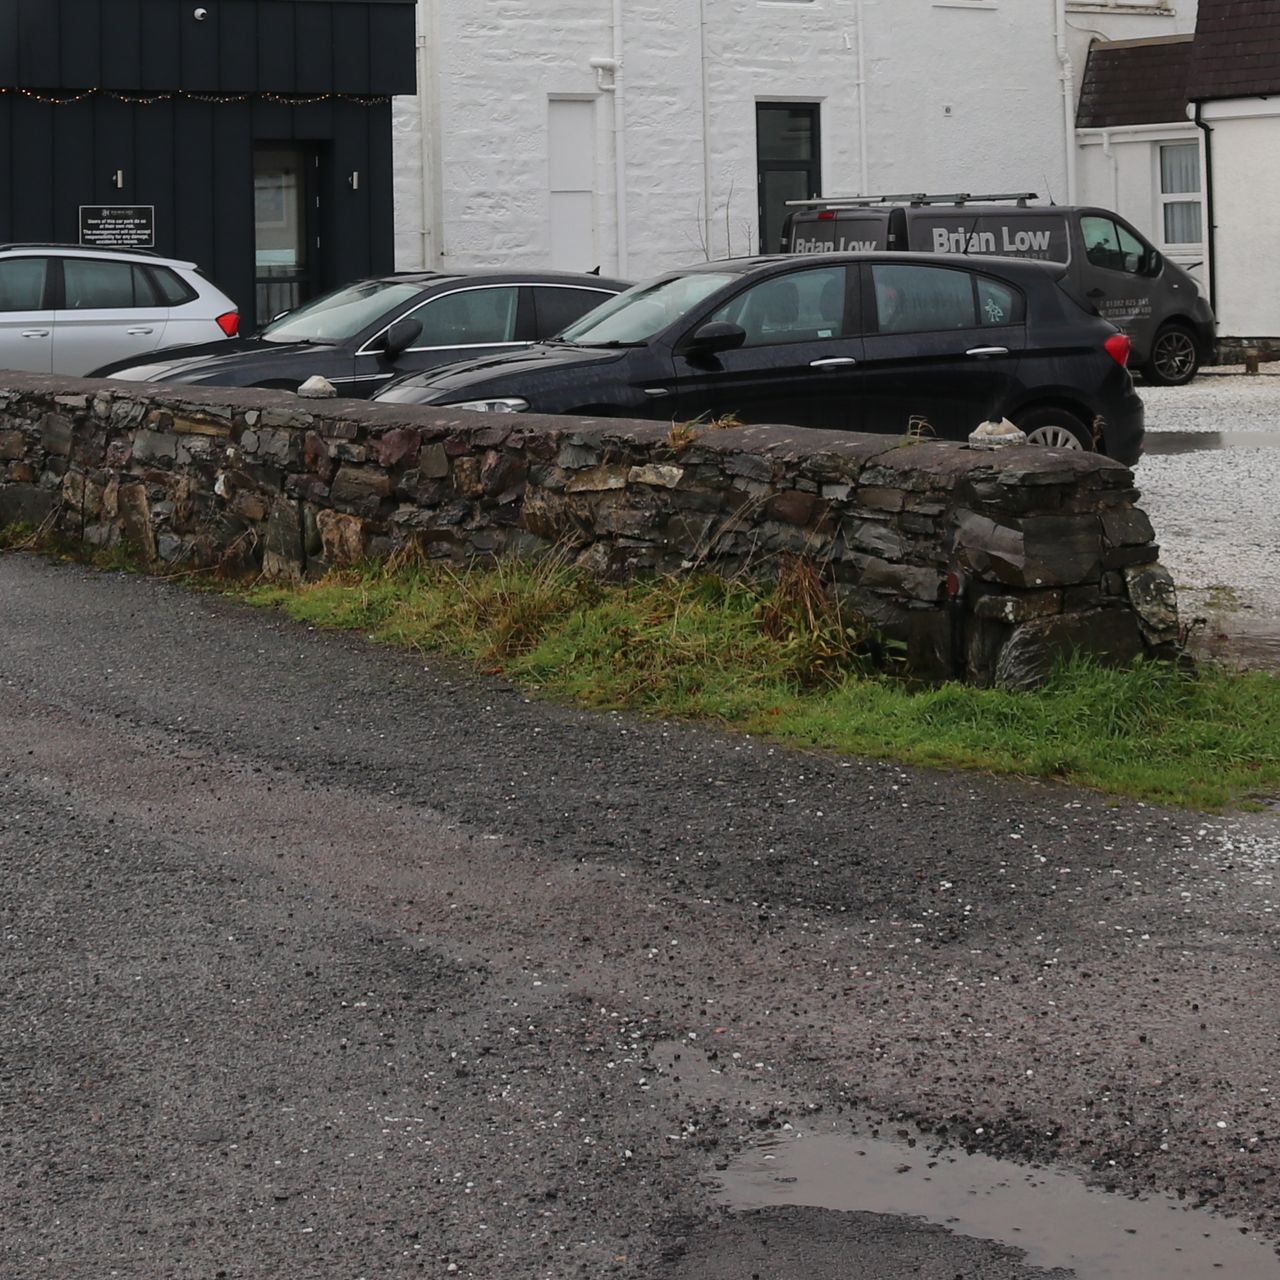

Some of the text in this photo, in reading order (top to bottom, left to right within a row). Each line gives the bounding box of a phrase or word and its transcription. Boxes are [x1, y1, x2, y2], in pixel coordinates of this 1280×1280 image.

[796, 237, 877, 254] Brian Low
[932, 226, 1050, 254] Brian Low
